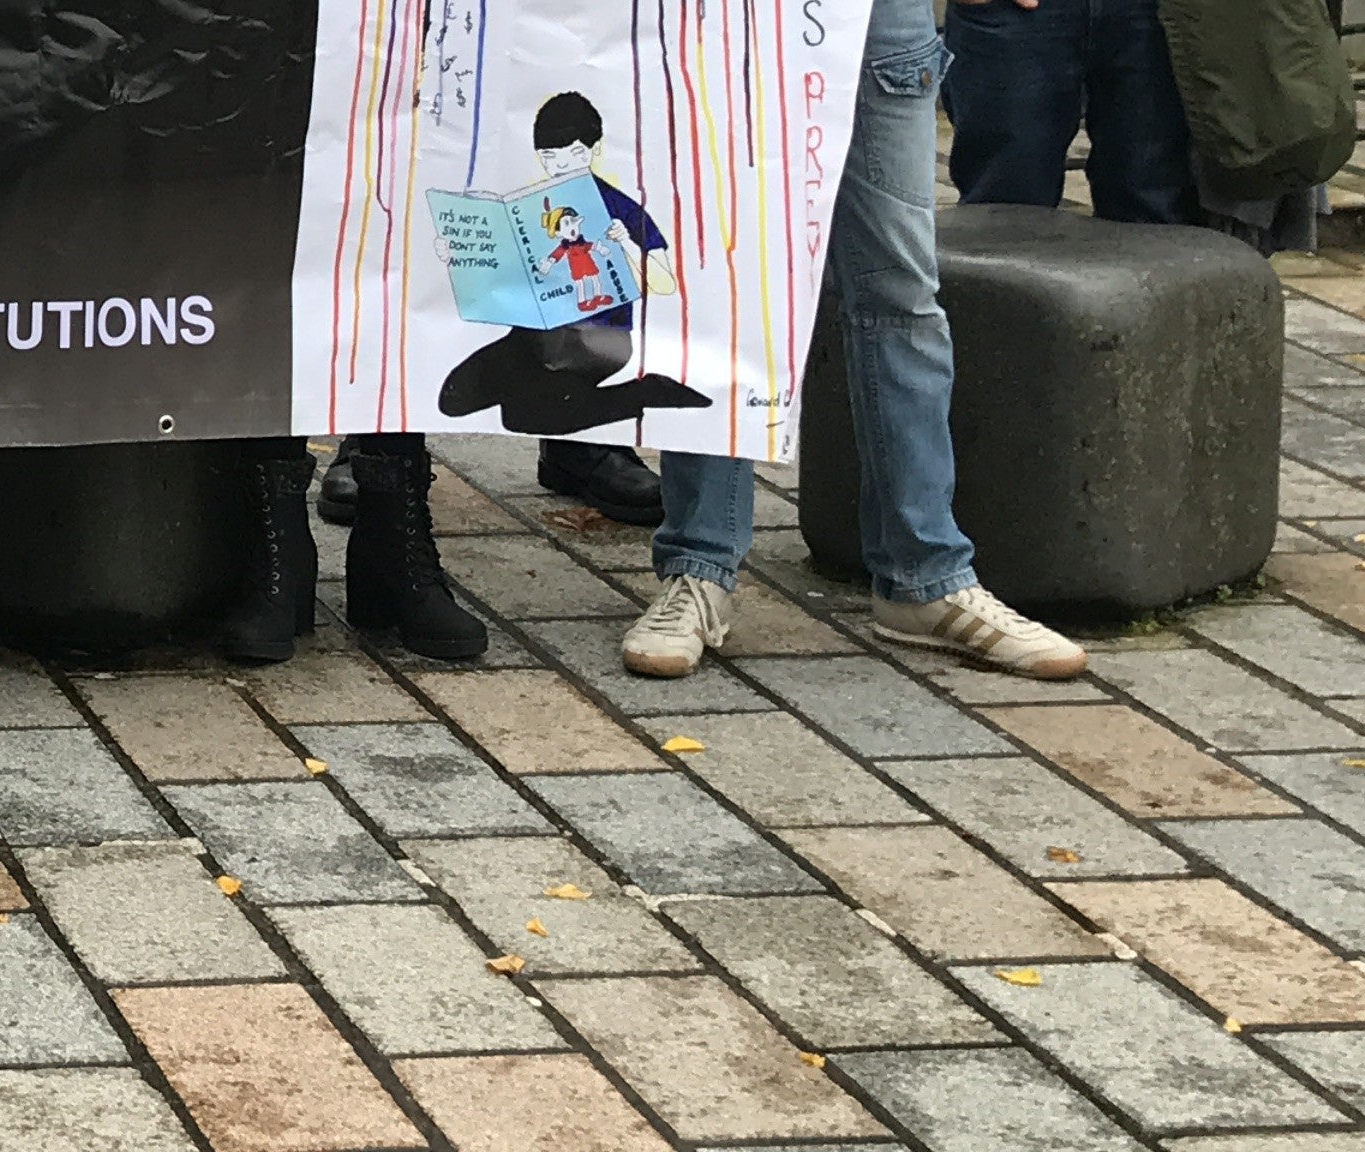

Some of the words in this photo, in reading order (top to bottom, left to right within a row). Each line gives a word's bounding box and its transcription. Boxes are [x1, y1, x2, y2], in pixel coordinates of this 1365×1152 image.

[481, 217, 488, 226] A
[442, 225, 460, 237] SIN
[463, 229, 473, 238] IF
[479, 242, 497, 253] SAY
[511, 205, 544, 285] CLERICAL
[447, 257, 499, 269] ANYTHING
[606, 259, 629, 302] ABUSE
[540, 284, 574, 302] CHILD
